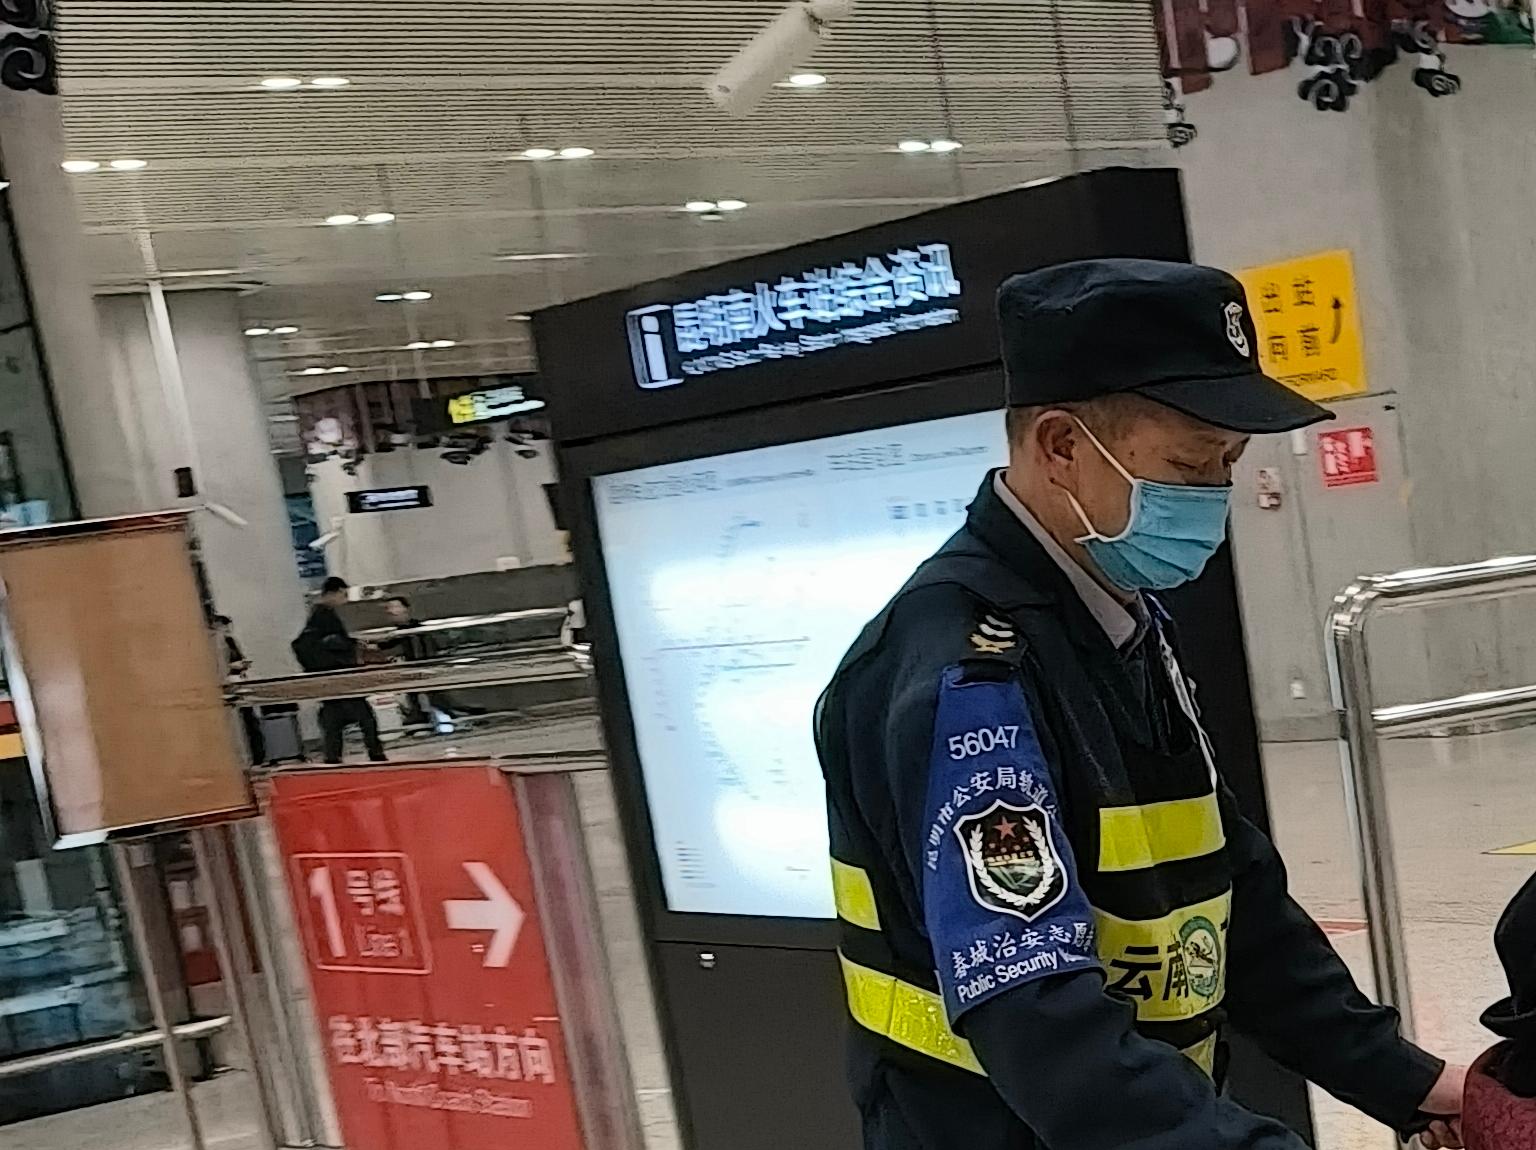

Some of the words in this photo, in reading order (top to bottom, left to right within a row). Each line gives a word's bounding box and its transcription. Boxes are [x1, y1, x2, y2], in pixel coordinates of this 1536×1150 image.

[948, 725, 1019, 760] 56047
[957, 973, 996, 1003] Public
[994, 950, 1058, 983] Security
